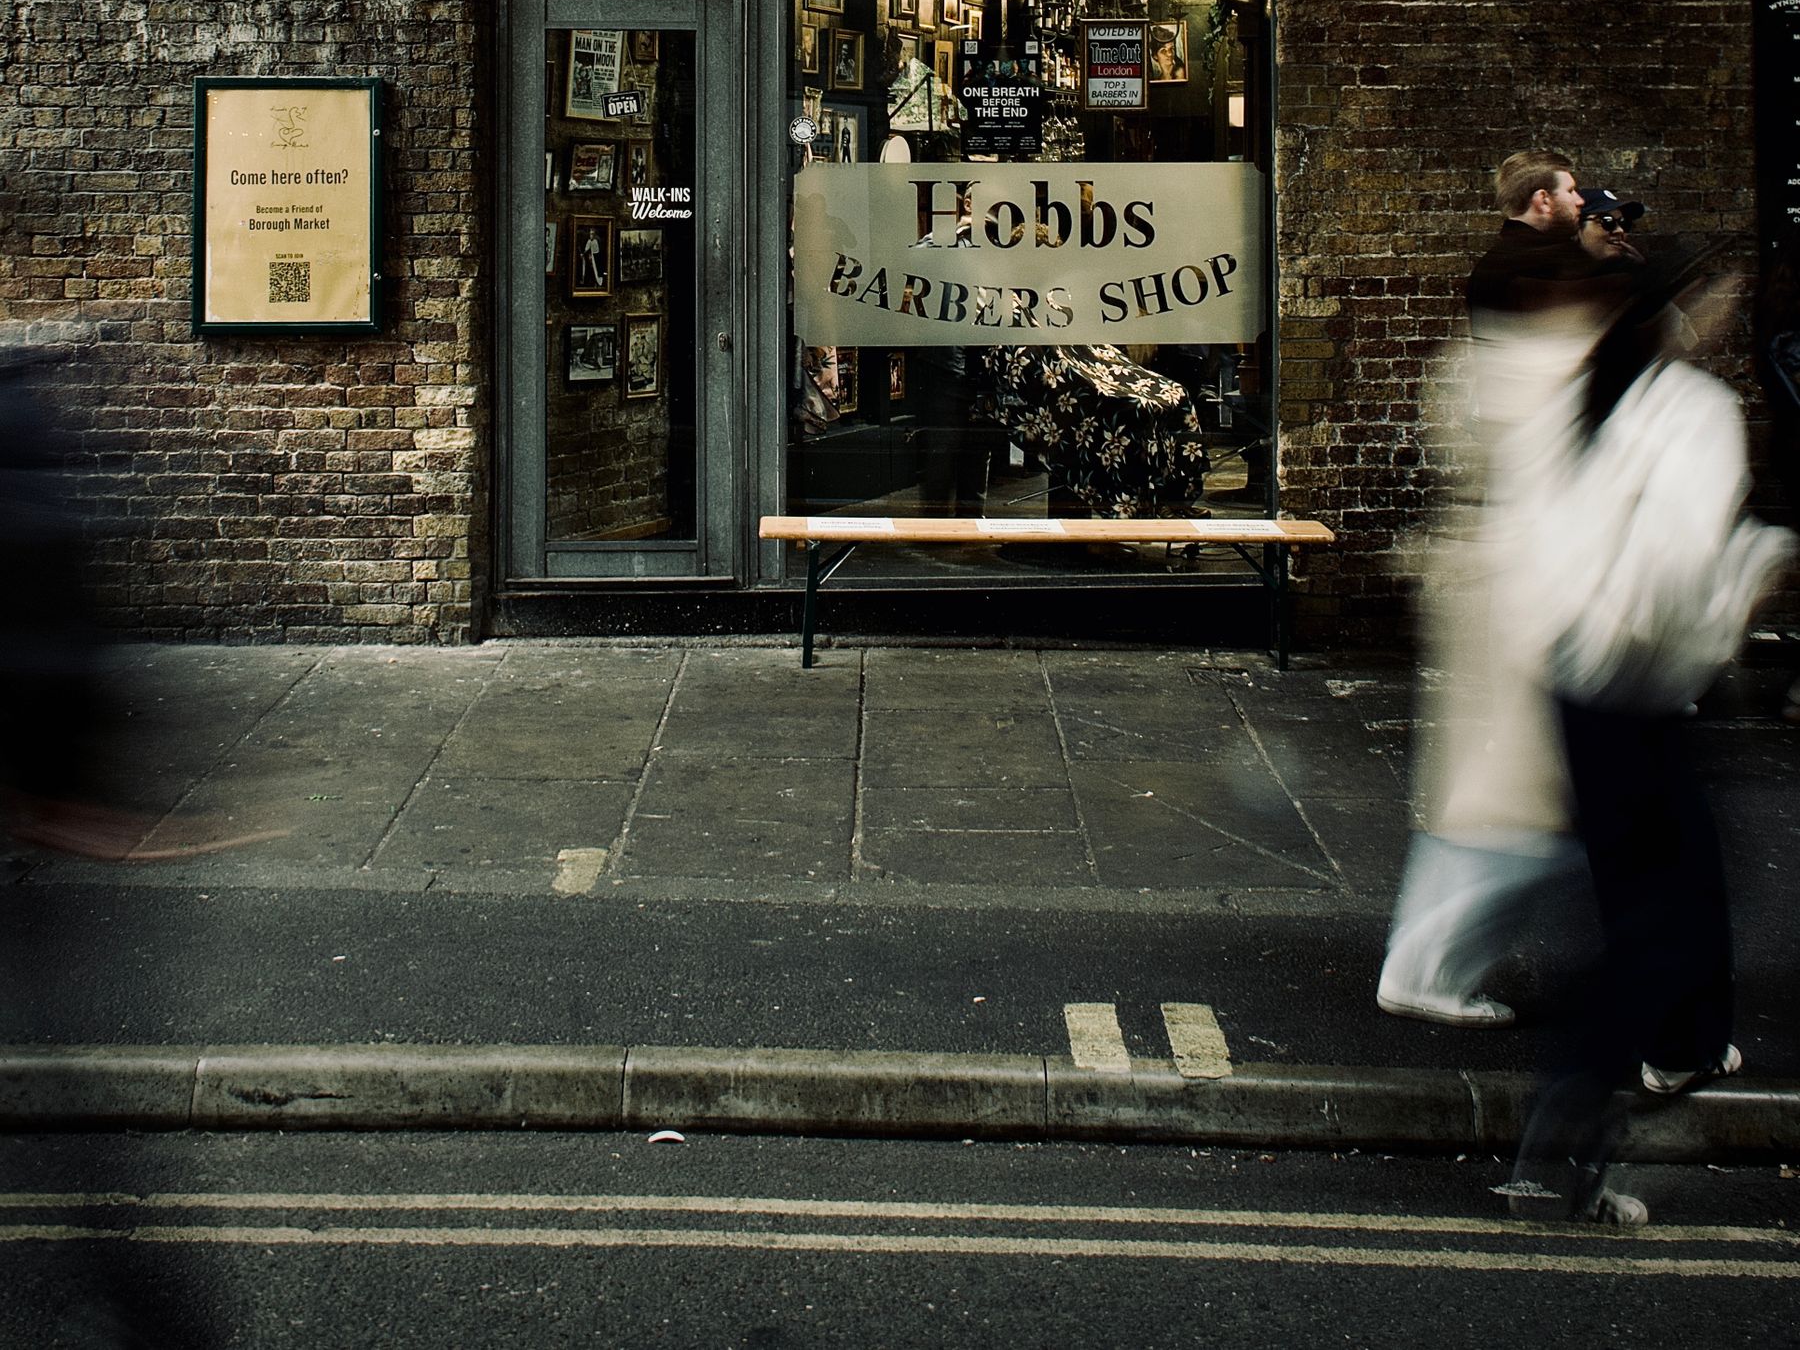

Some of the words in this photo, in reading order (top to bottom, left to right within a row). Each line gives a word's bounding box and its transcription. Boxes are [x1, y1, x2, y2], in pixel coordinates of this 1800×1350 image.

[1091, 27, 1125, 37] VOTED
[1127, 27, 1140, 37] BY
[575, 36, 592, 50] MAN
[593, 39, 603, 52] ON
[605, 40, 617, 54] THE
[595, 53, 615, 68] MOON
[1097, 66, 1133, 76] London
[963, 87, 989, 97] ONE
[992, 87, 1039, 97] BREATH
[1104, 81, 1120, 89] TOP
[1121, 81, 1126, 89] 3
[1091, 90, 1127, 98] BARBERS
[1129, 90, 1138, 98] IN
[608, 100, 638, 115] OPEN
[982, 98, 1020, 106] BEFORE
[975, 107, 999, 117] THE
[1002, 107, 1028, 117] END
[230, 170, 267, 185] Come
[271, 170, 301, 184] here
[305, 169, 348, 184] often?
[632, 187, 690, 202] WALK-INS
[256, 205, 283, 213] Become
[292, 205, 314, 213] Friend
[316, 205, 322, 213] of
[627, 202, 692, 219] Welcome
[907, 179, 1155, 249] Hobbs
[249, 218, 290, 232] Borough
[294, 218, 329, 230] Market
[826, 251, 1075, 329] BARBERS
[1098, 252, 1238, 324] SHOP
